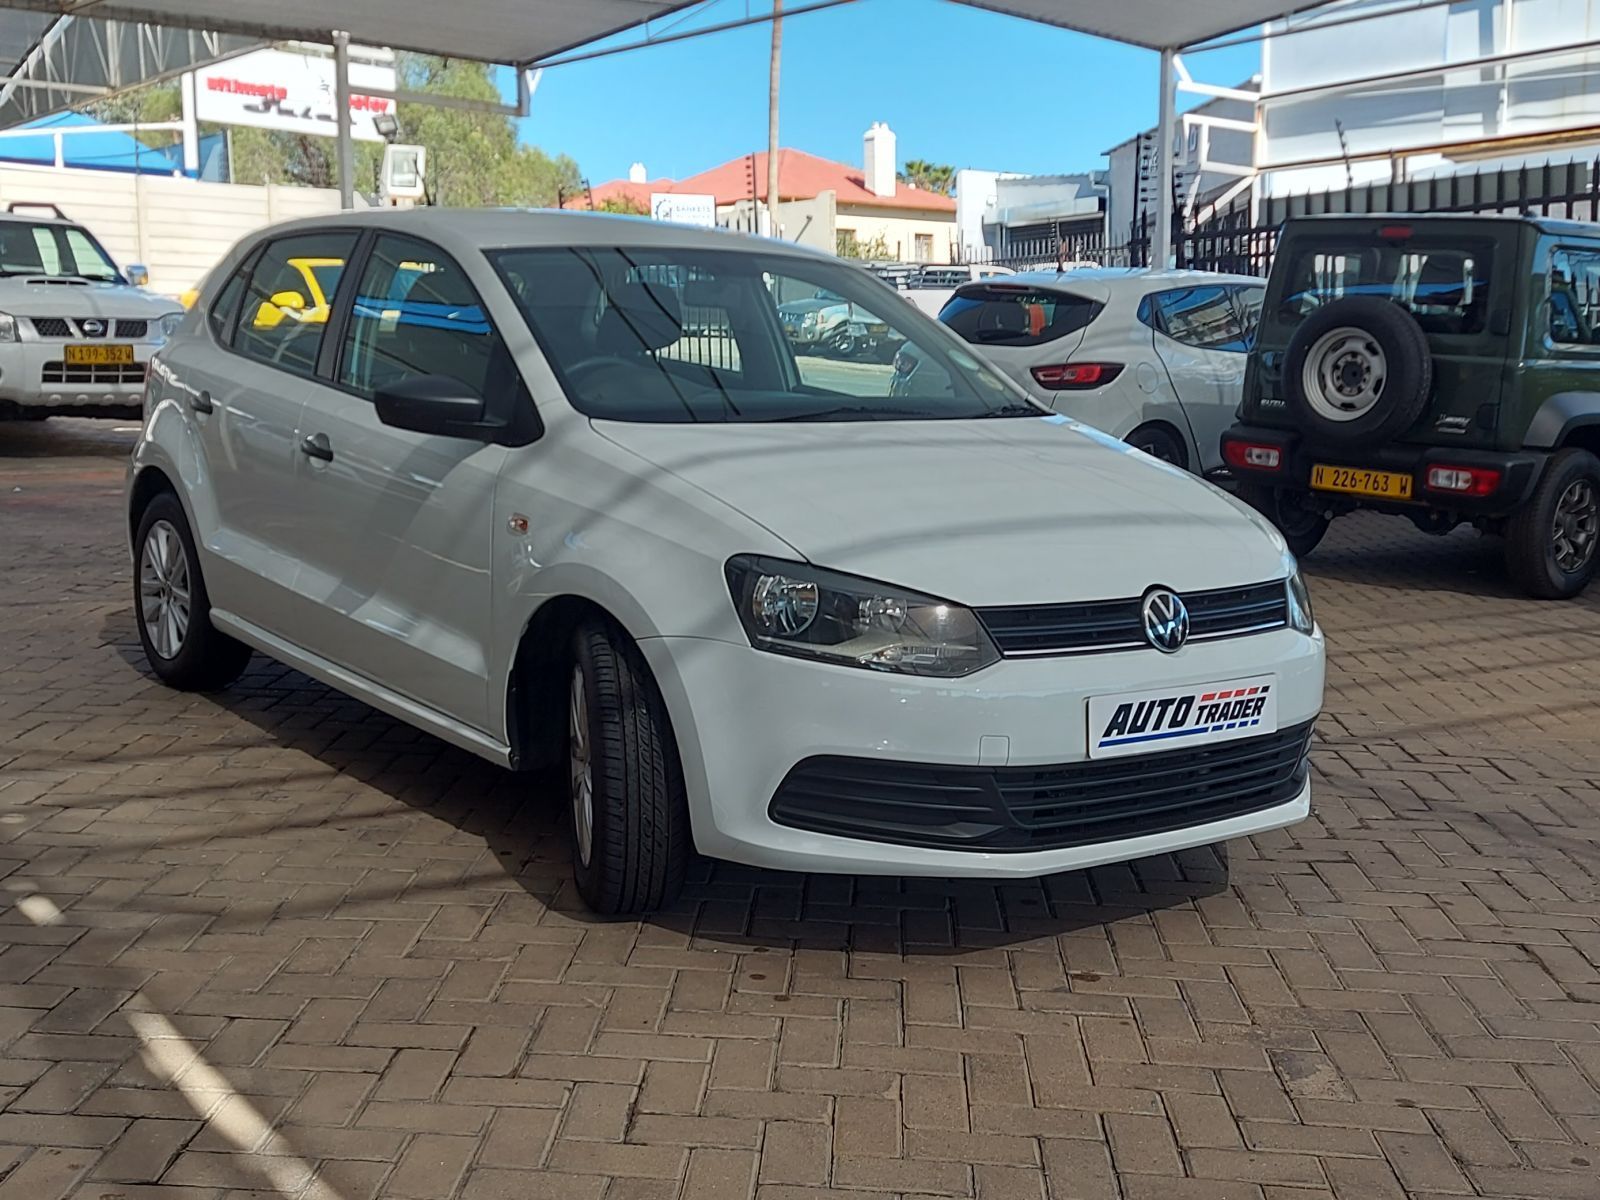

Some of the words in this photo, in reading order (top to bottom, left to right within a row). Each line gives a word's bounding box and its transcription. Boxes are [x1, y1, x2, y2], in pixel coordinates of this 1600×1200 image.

[68, 348, 75, 360] N
[1315, 467, 1324, 485] N
[1332, 469, 1389, 492] 226-763
[1399, 476, 1408, 495] W
[1102, 695, 1196, 737] AUTO
[1194, 697, 1266, 726] TRADER
